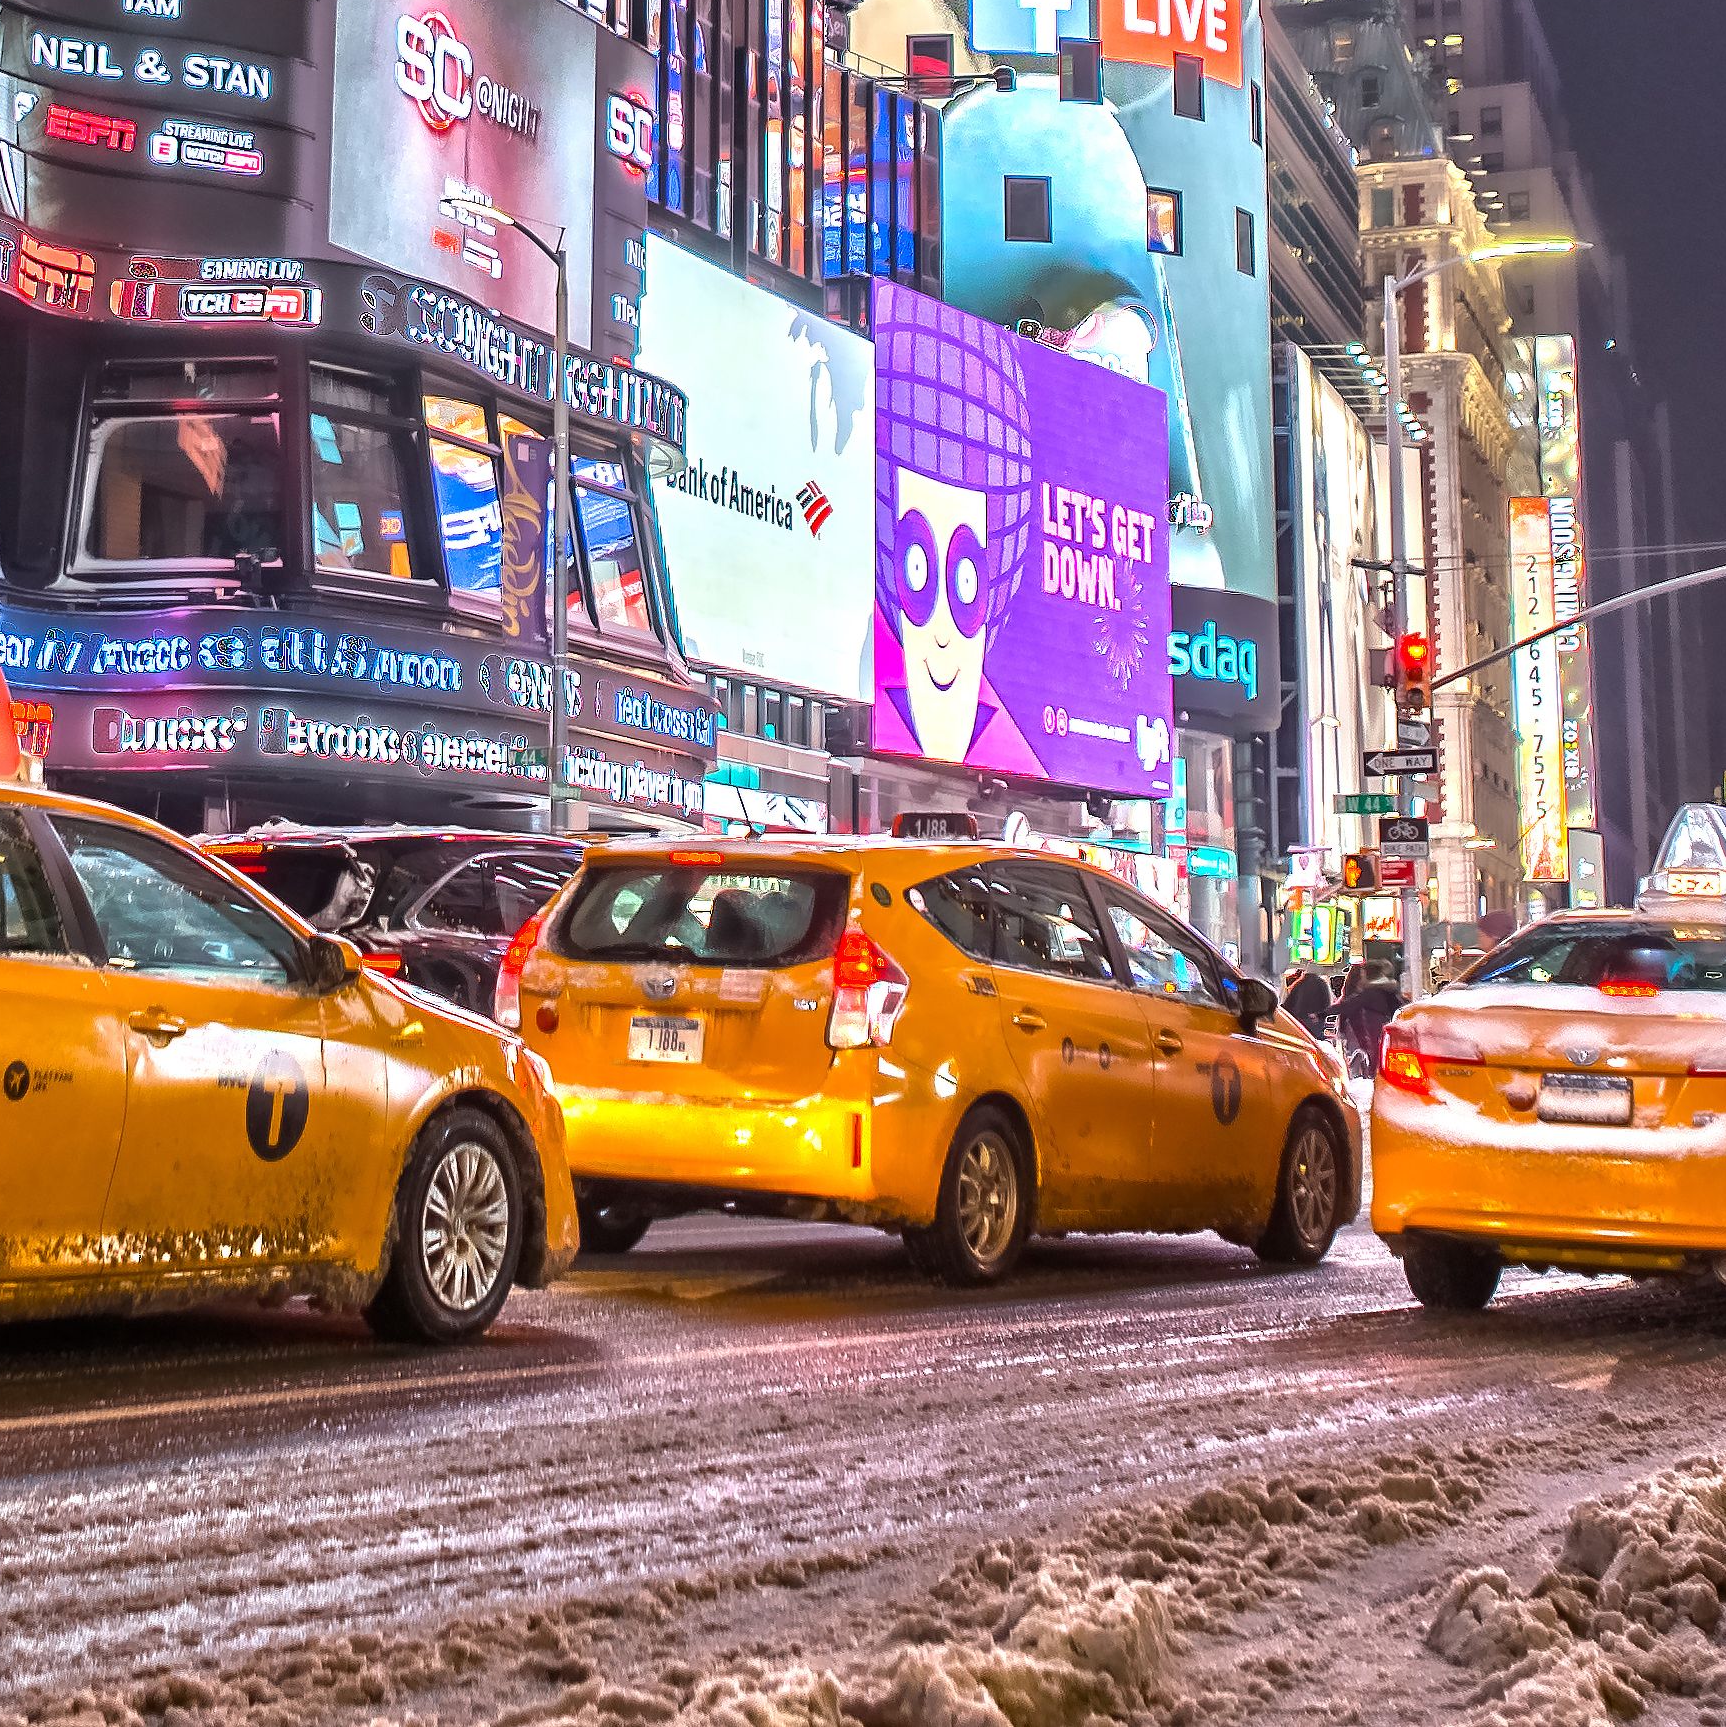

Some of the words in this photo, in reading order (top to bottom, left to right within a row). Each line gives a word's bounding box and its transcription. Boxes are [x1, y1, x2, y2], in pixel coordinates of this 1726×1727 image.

[30, 30, 124, 80] NEIL
[134, 47, 172, 85] &
[181, 52, 273, 102] STAN
[395, 13, 473, 121] SC
[474, 73, 542, 140] @NIGHT
[45, 102, 138, 153] ESPN
[163, 119, 228, 148] STREAMING
[227, 131, 256, 151] LIVE
[184, 145, 225, 166] WATCH
[710, 466, 729, 509] of
[729, 469, 795, 532] America
[1040, 480, 1107, 551] LET'S
[1110, 503, 1156, 565] GET
[1041, 547, 1123, 612] DOWN.
[1373, 758, 1396, 768] ONE
[1405, 756, 1429, 768] WAY
[1364, 797, 1381, 811] 44
